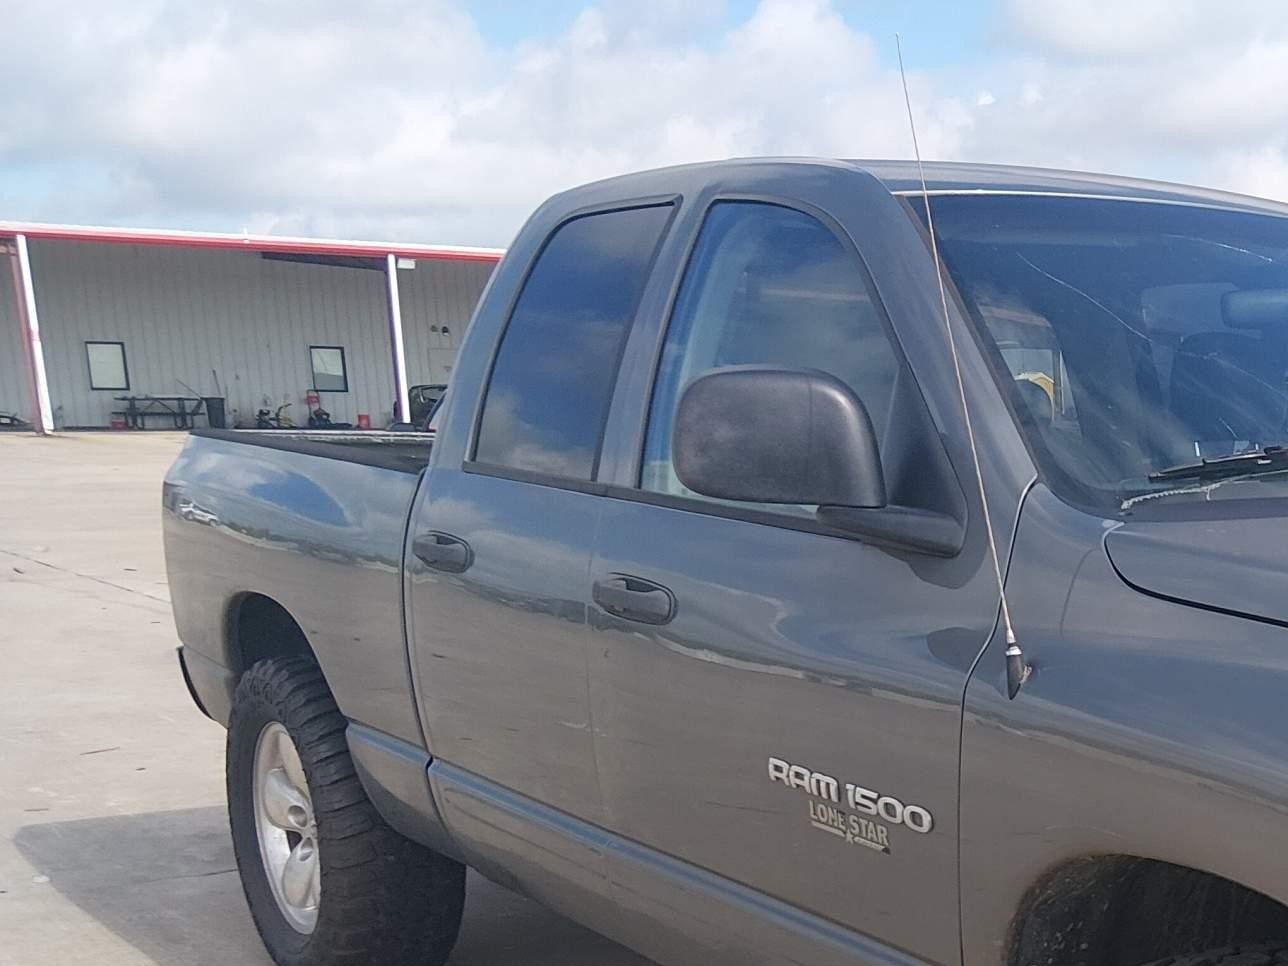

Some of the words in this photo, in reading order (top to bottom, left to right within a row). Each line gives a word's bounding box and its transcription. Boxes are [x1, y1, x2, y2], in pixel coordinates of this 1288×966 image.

[768, 757, 840, 802] RAM
[846, 783, 932, 833] 1500
[809, 800, 846, 830] LONE
[850, 814, 889, 846] STAR
